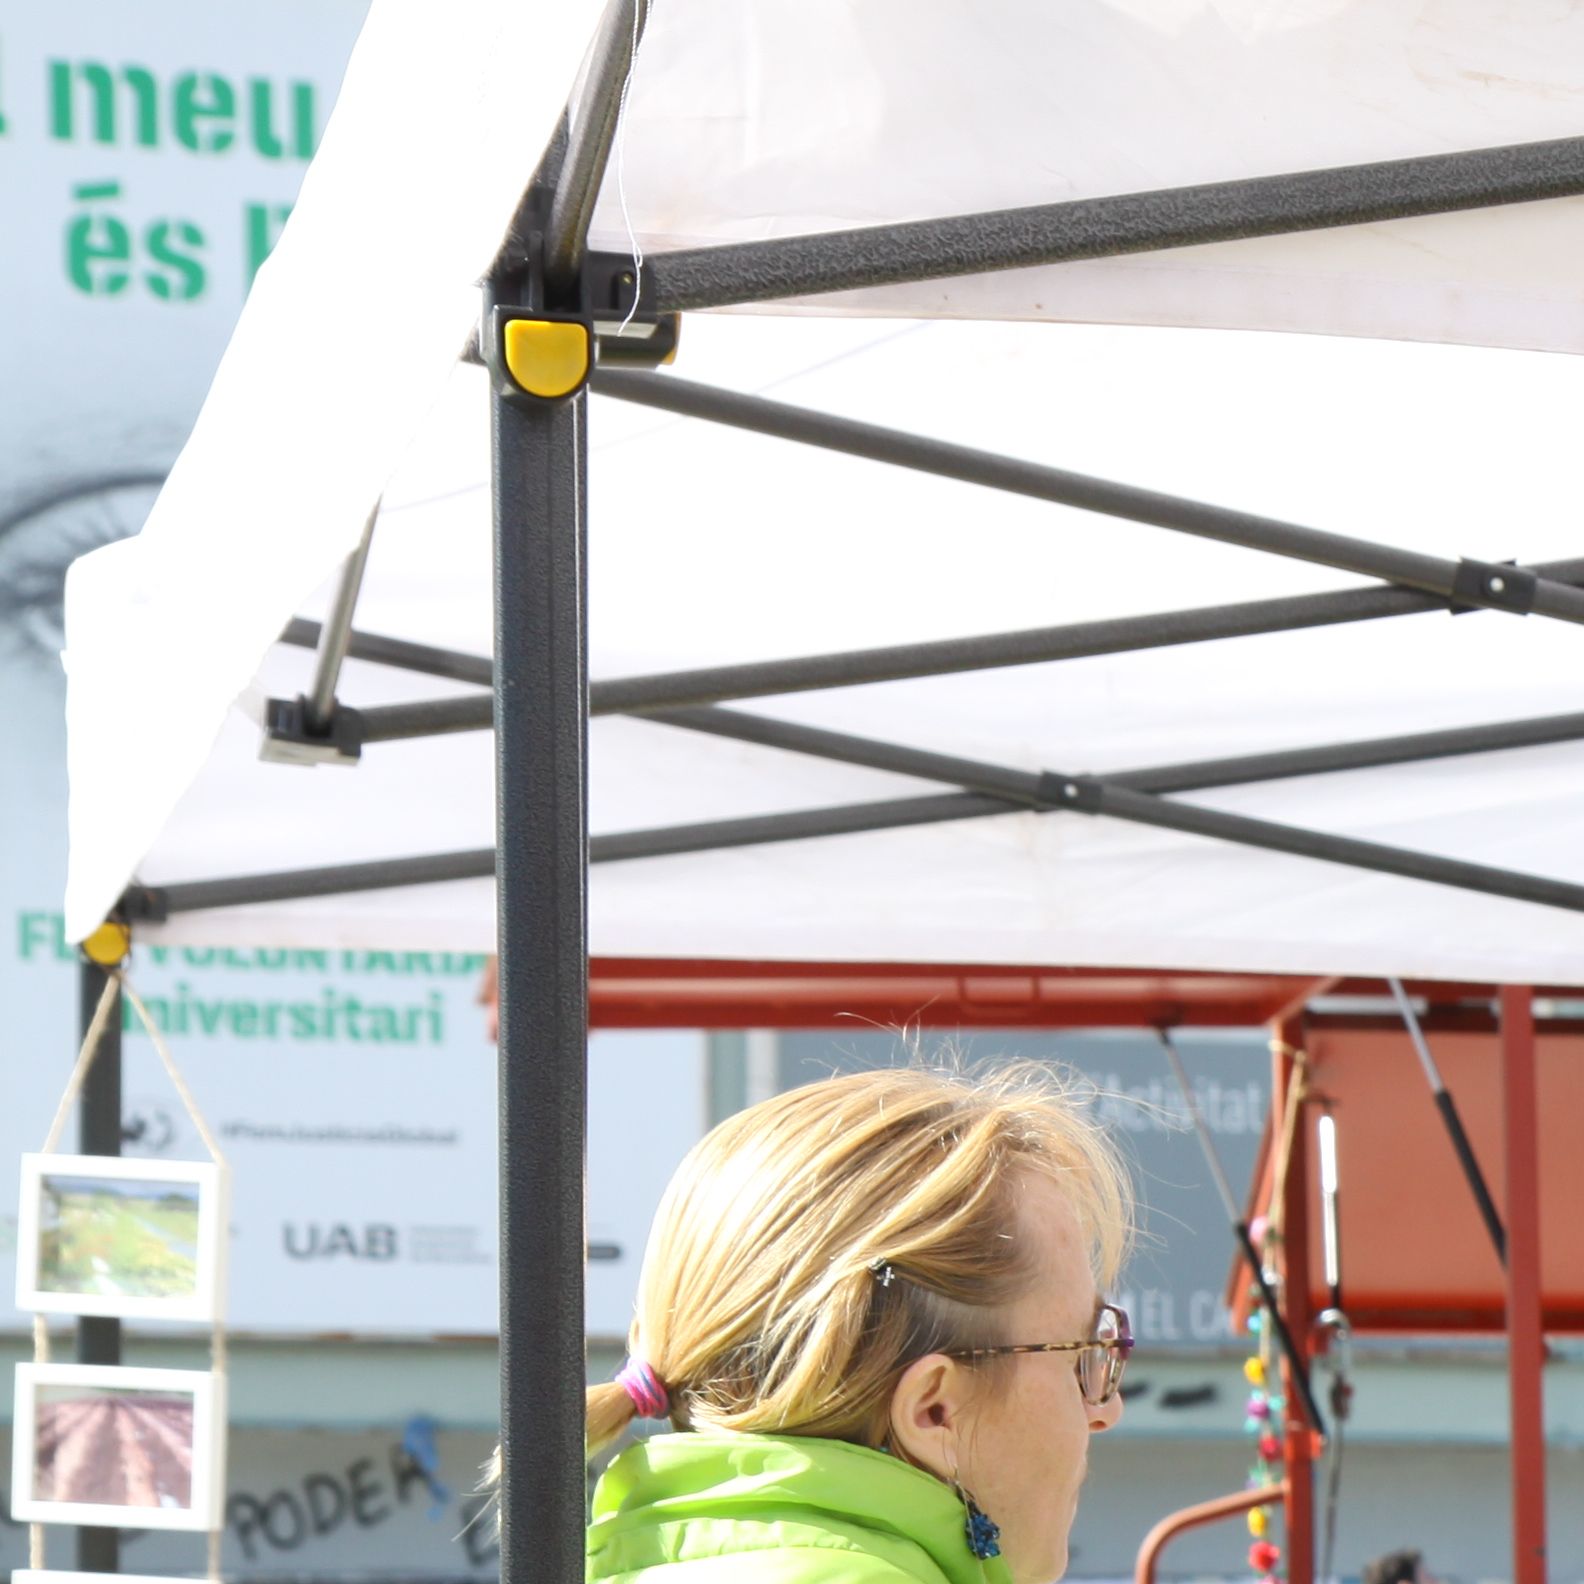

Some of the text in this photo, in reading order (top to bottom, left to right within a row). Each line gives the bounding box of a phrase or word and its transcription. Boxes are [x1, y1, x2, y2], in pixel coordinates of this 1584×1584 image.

[50, 58, 316, 160] meu
[66, 181, 208, 301] és
[281, 1223, 399, 1262] UAB
